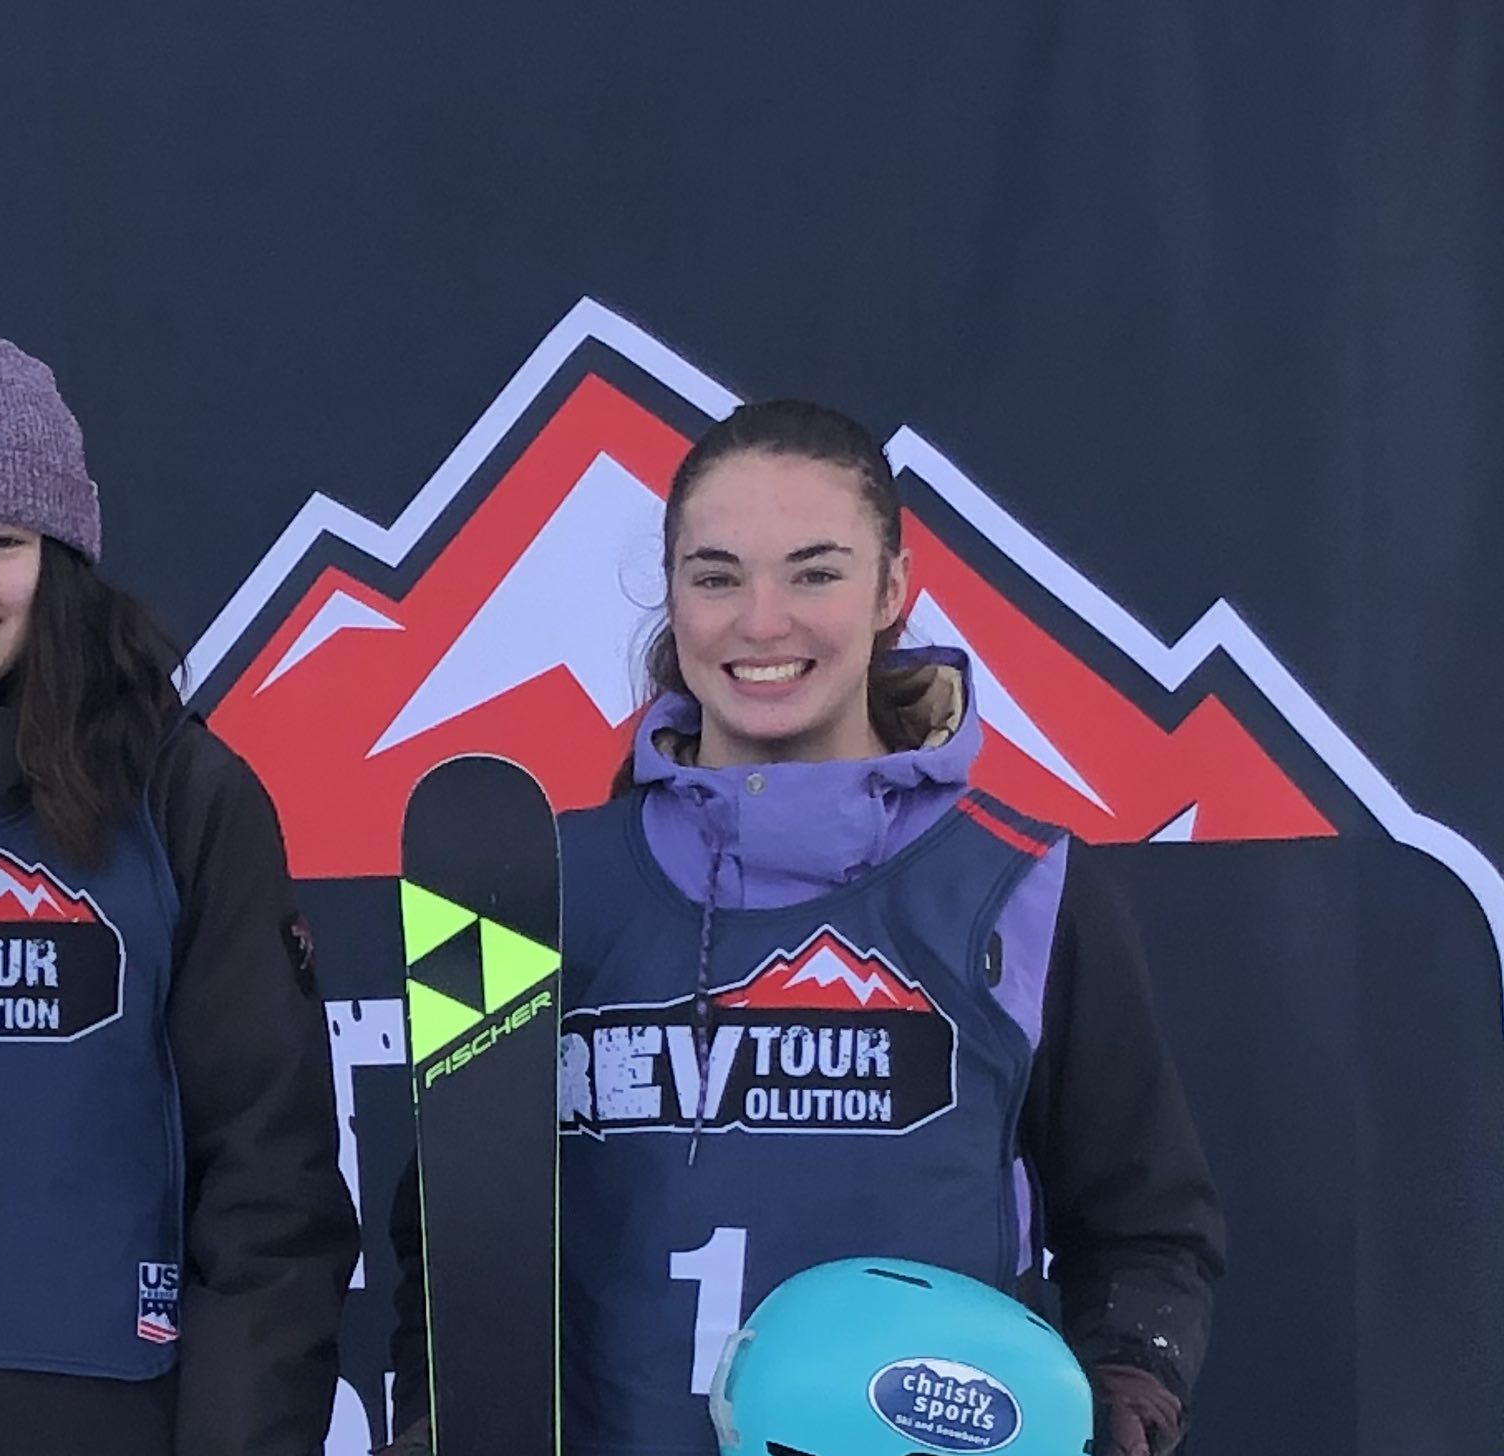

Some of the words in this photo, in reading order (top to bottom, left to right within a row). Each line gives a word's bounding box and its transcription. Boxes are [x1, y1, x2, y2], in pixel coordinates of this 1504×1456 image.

[425, 991, 553, 1089] FISCHER
[748, 1025, 891, 1078] TOUR
[746, 1088, 891, 1122] OLUTION
[141, 1265, 178, 1291] US
[669, 1226, 747, 1395] 1
[902, 1372, 993, 1416] christy
[912, 1396, 996, 1431] sports
